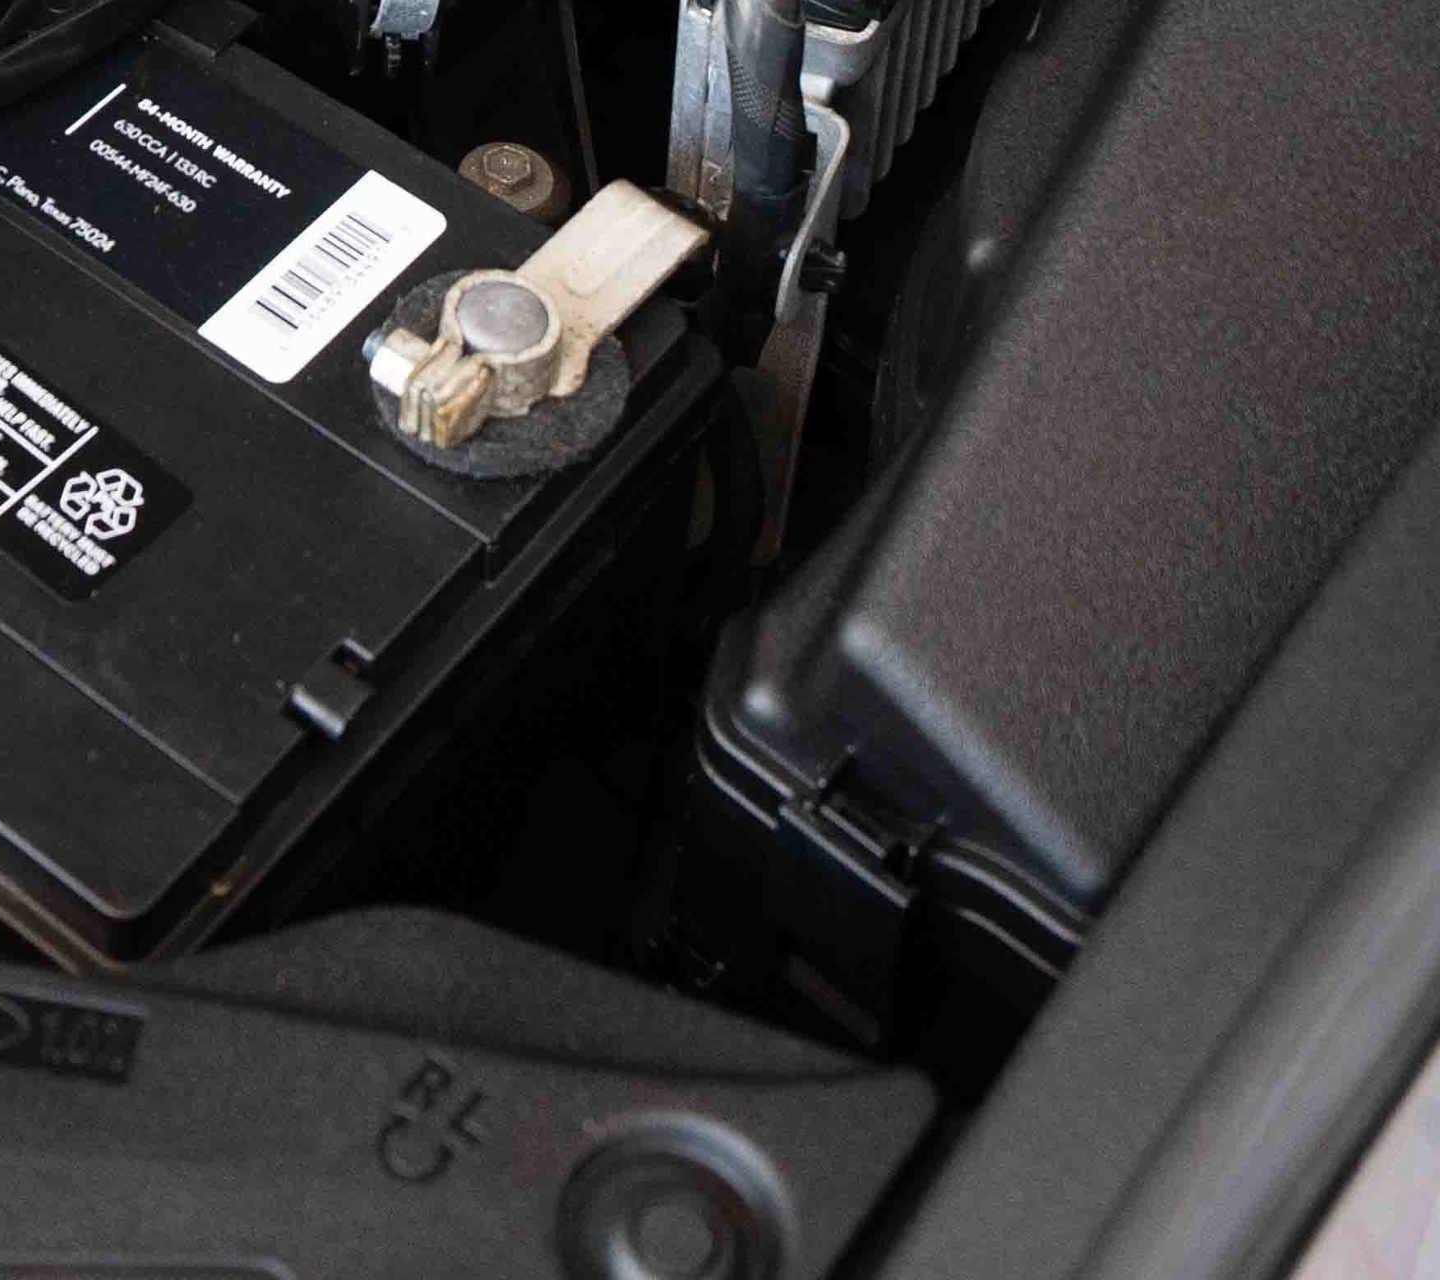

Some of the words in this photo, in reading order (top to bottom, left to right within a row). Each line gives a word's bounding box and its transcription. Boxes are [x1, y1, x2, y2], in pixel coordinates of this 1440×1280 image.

[113, 119, 142, 140] 630
[138, 133, 167, 158] CCA
[174, 157, 198, 176] 133
[193, 169, 217, 188] RC
[138, 98, 214, 150] 84-MONTH
[213, 144, 291, 199] WARRANTY
[40, 197, 71, 226] Texas
[68, 216, 116, 253] 75024
